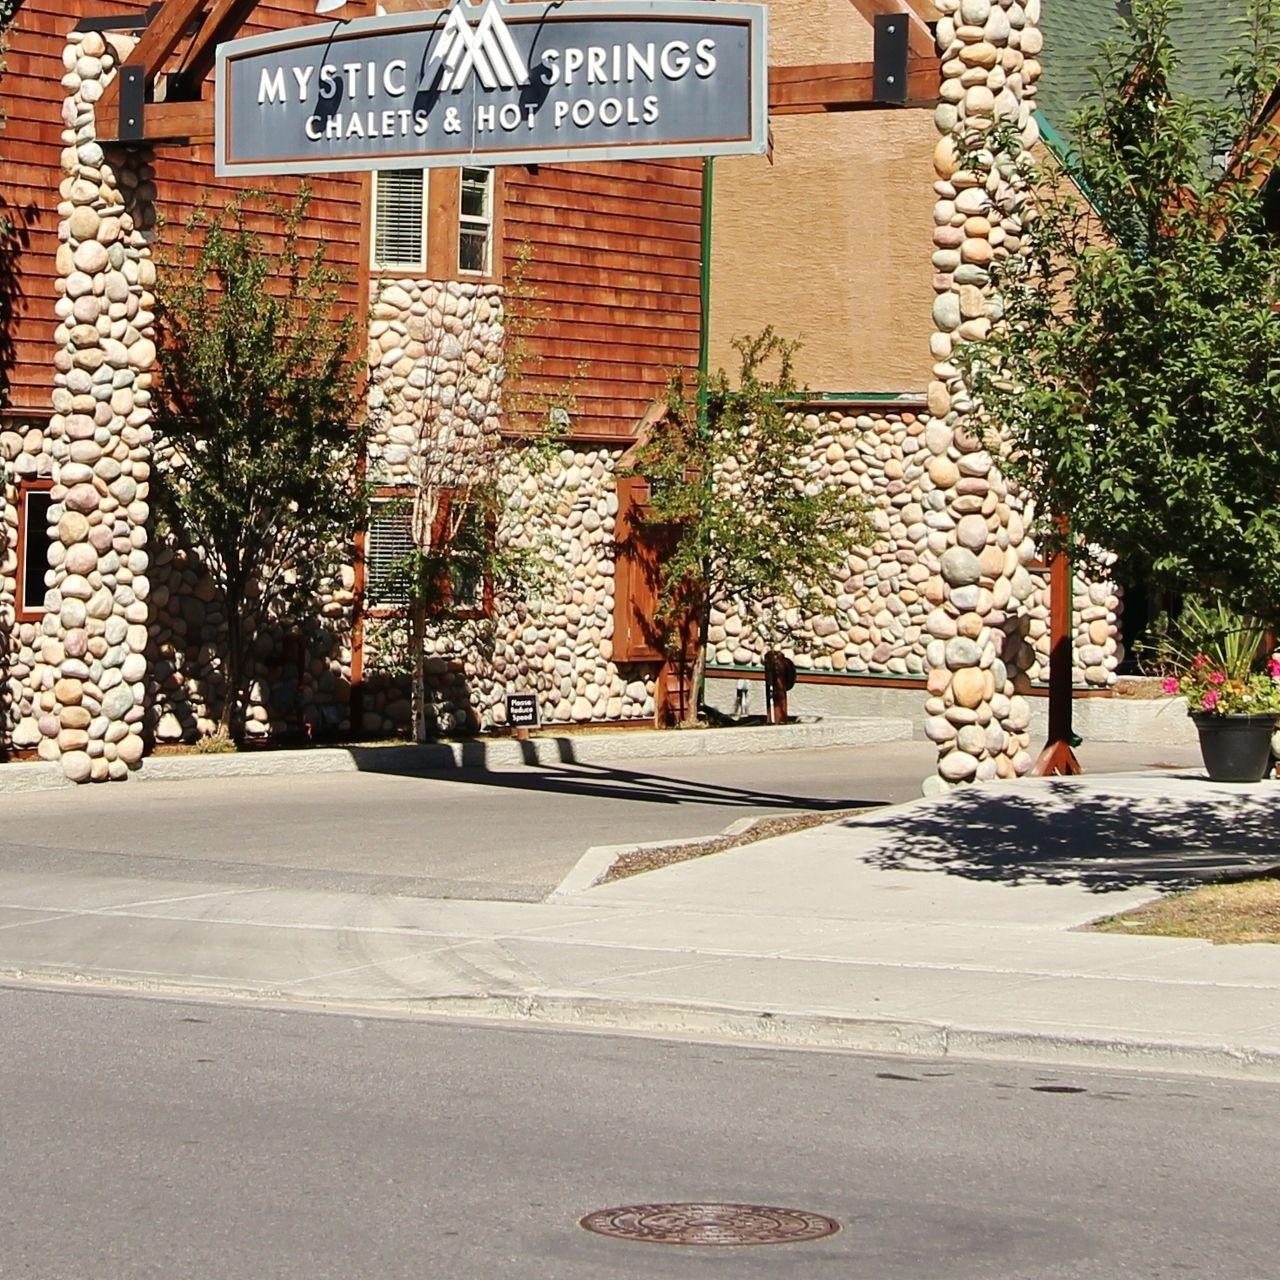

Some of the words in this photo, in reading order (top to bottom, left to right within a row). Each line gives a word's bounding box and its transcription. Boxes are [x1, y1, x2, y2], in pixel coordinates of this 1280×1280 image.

[257, 59, 407, 104] MYSTIC
[540, 38, 718, 86] SPRINGS
[304, 109, 429, 140] CHALETS
[443, 106, 463, 133] &
[477, 103, 539, 131] HOT
[554, 95, 660, 129] POOLS
